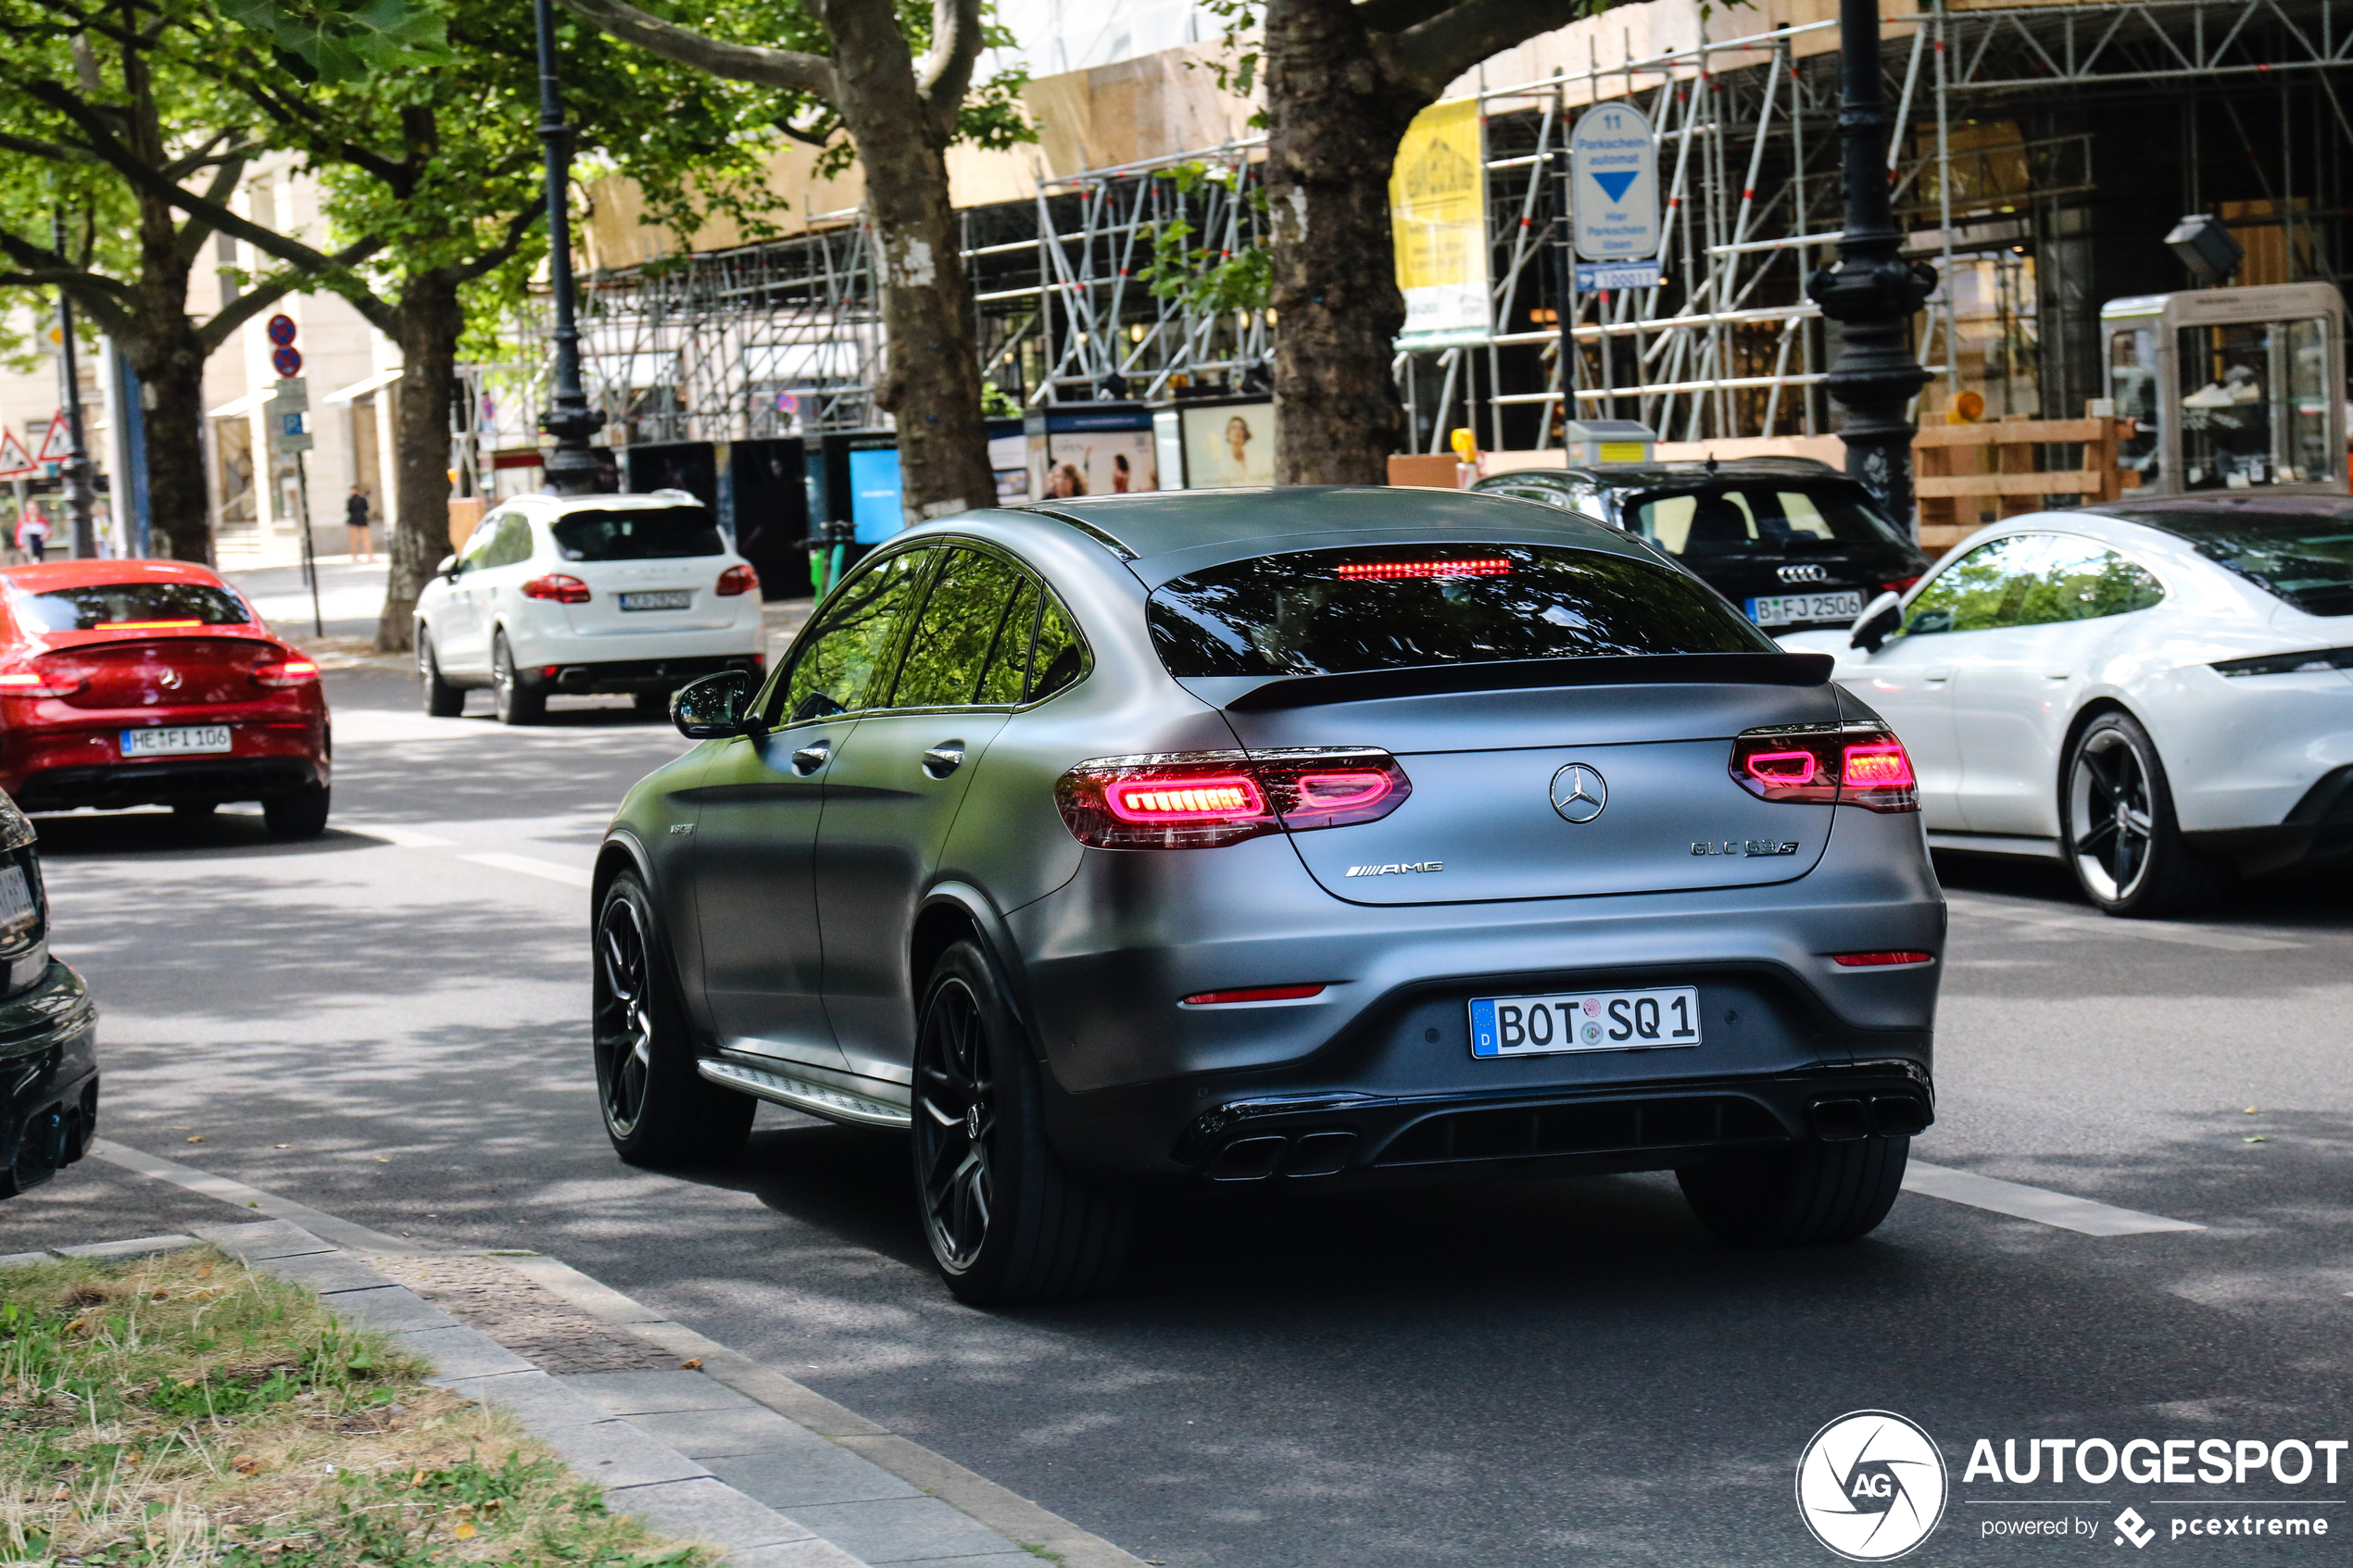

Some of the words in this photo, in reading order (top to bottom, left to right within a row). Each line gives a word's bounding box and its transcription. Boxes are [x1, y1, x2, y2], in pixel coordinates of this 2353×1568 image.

[1604, 115, 1621, 130] 11
[1590, 153, 1639, 165] automat
[1605, 212, 1628, 221] Hier
[1587, 226, 1647, 236] Parkschein
[1758, 601, 1771, 619] B
[1783, 598, 1808, 618] FJ
[1814, 596, 1859, 616] 2506
[132, 733, 157, 748] HE
[169, 731, 190, 746] FI
[195, 730, 227, 746] 106
[1691, 841, 1738, 856] GLC
[1378, 861, 1444, 875] AMG
[1498, 1002, 1579, 1047] BOT
[1608, 997, 1661, 1041] SQ
[1670, 996, 1695, 1038] 1
[1481, 1034, 1491, 1046] D
